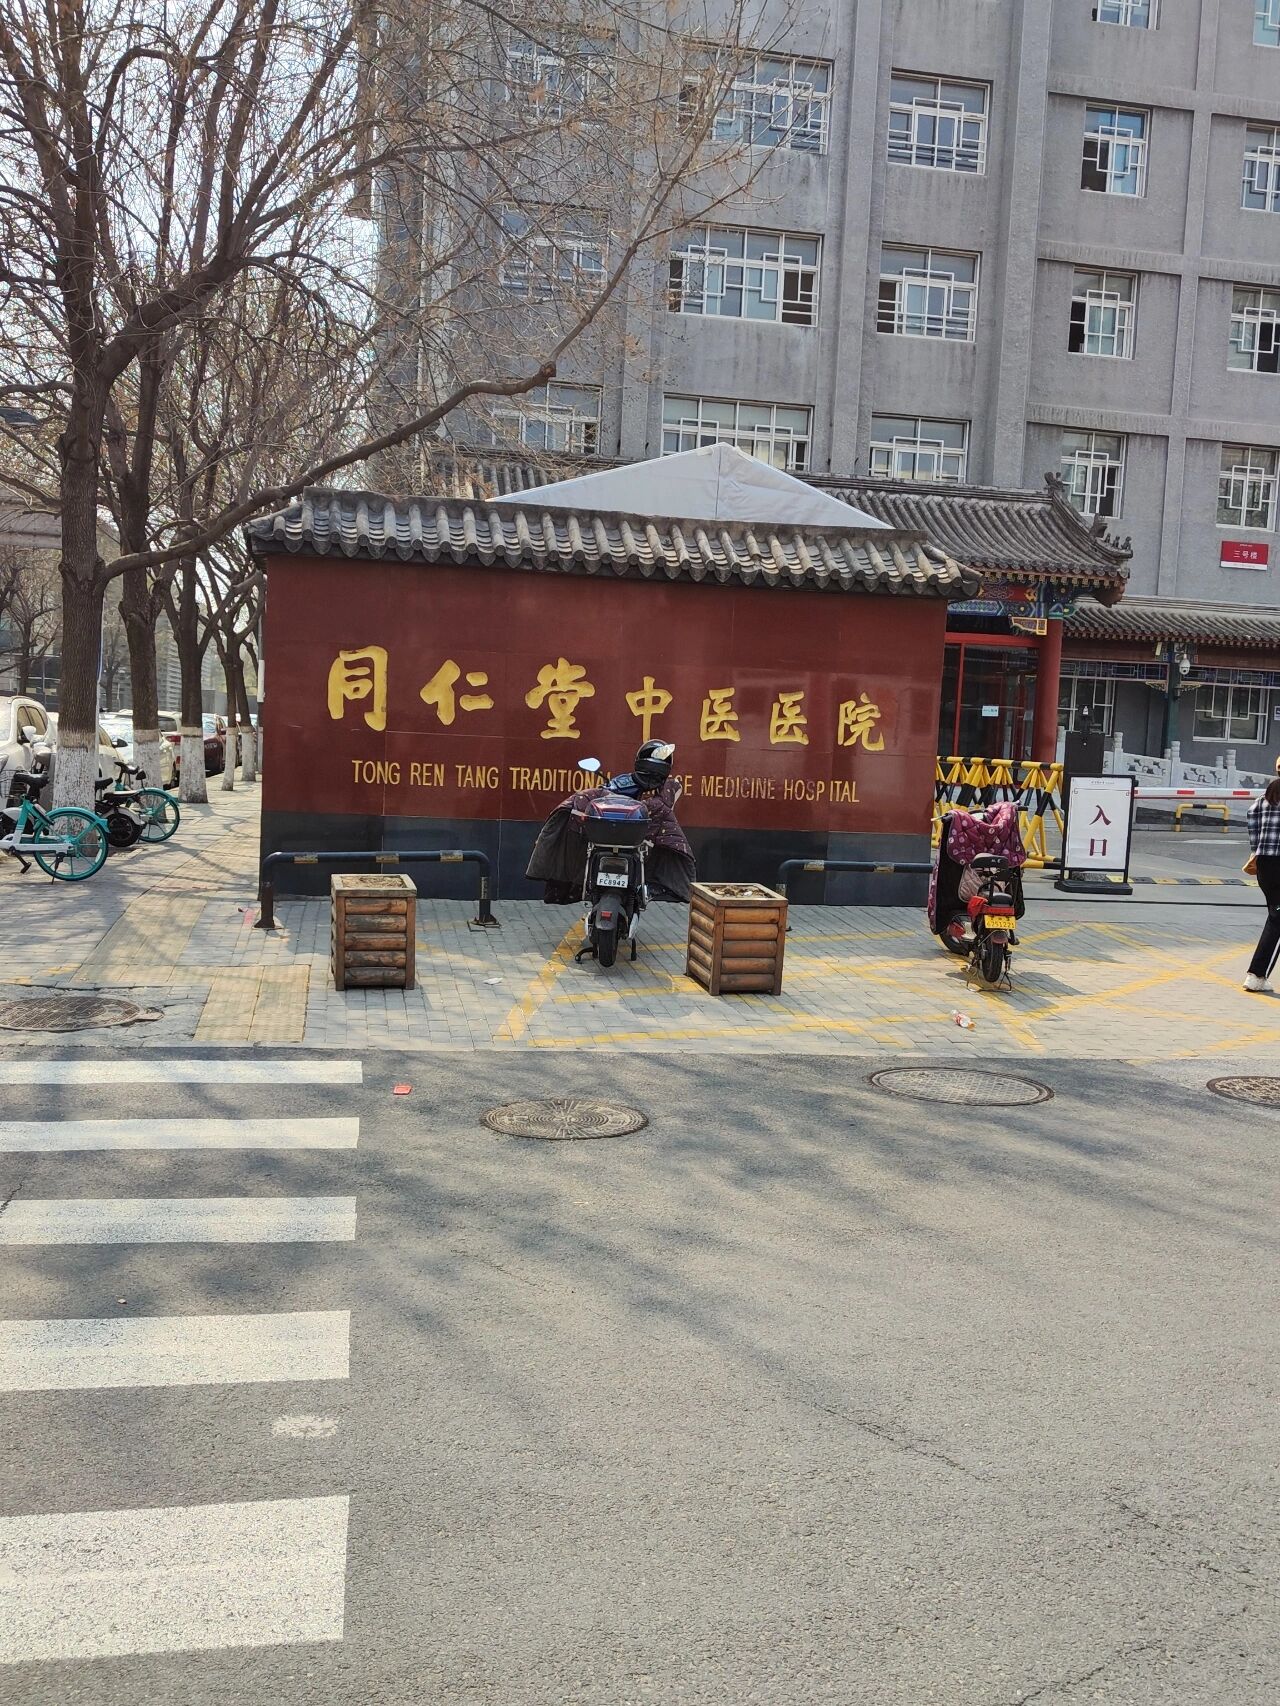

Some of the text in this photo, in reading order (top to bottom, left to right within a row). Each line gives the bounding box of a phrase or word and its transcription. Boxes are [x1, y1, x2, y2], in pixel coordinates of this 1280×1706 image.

[1233, 550, 1258, 560] 三号楼
[328, 645, 885, 750] 同仁堂中医医院
[352, 760, 400, 785] TONG
[410, 762, 444, 787] REN
[455, 765, 499, 789] TANG
[700, 775, 776, 800] MEDICINE
[783, 778, 860, 803] HOSPITAL
[1089, 804, 1111, 856] 入口
[599, 878, 626, 887] FC8942
